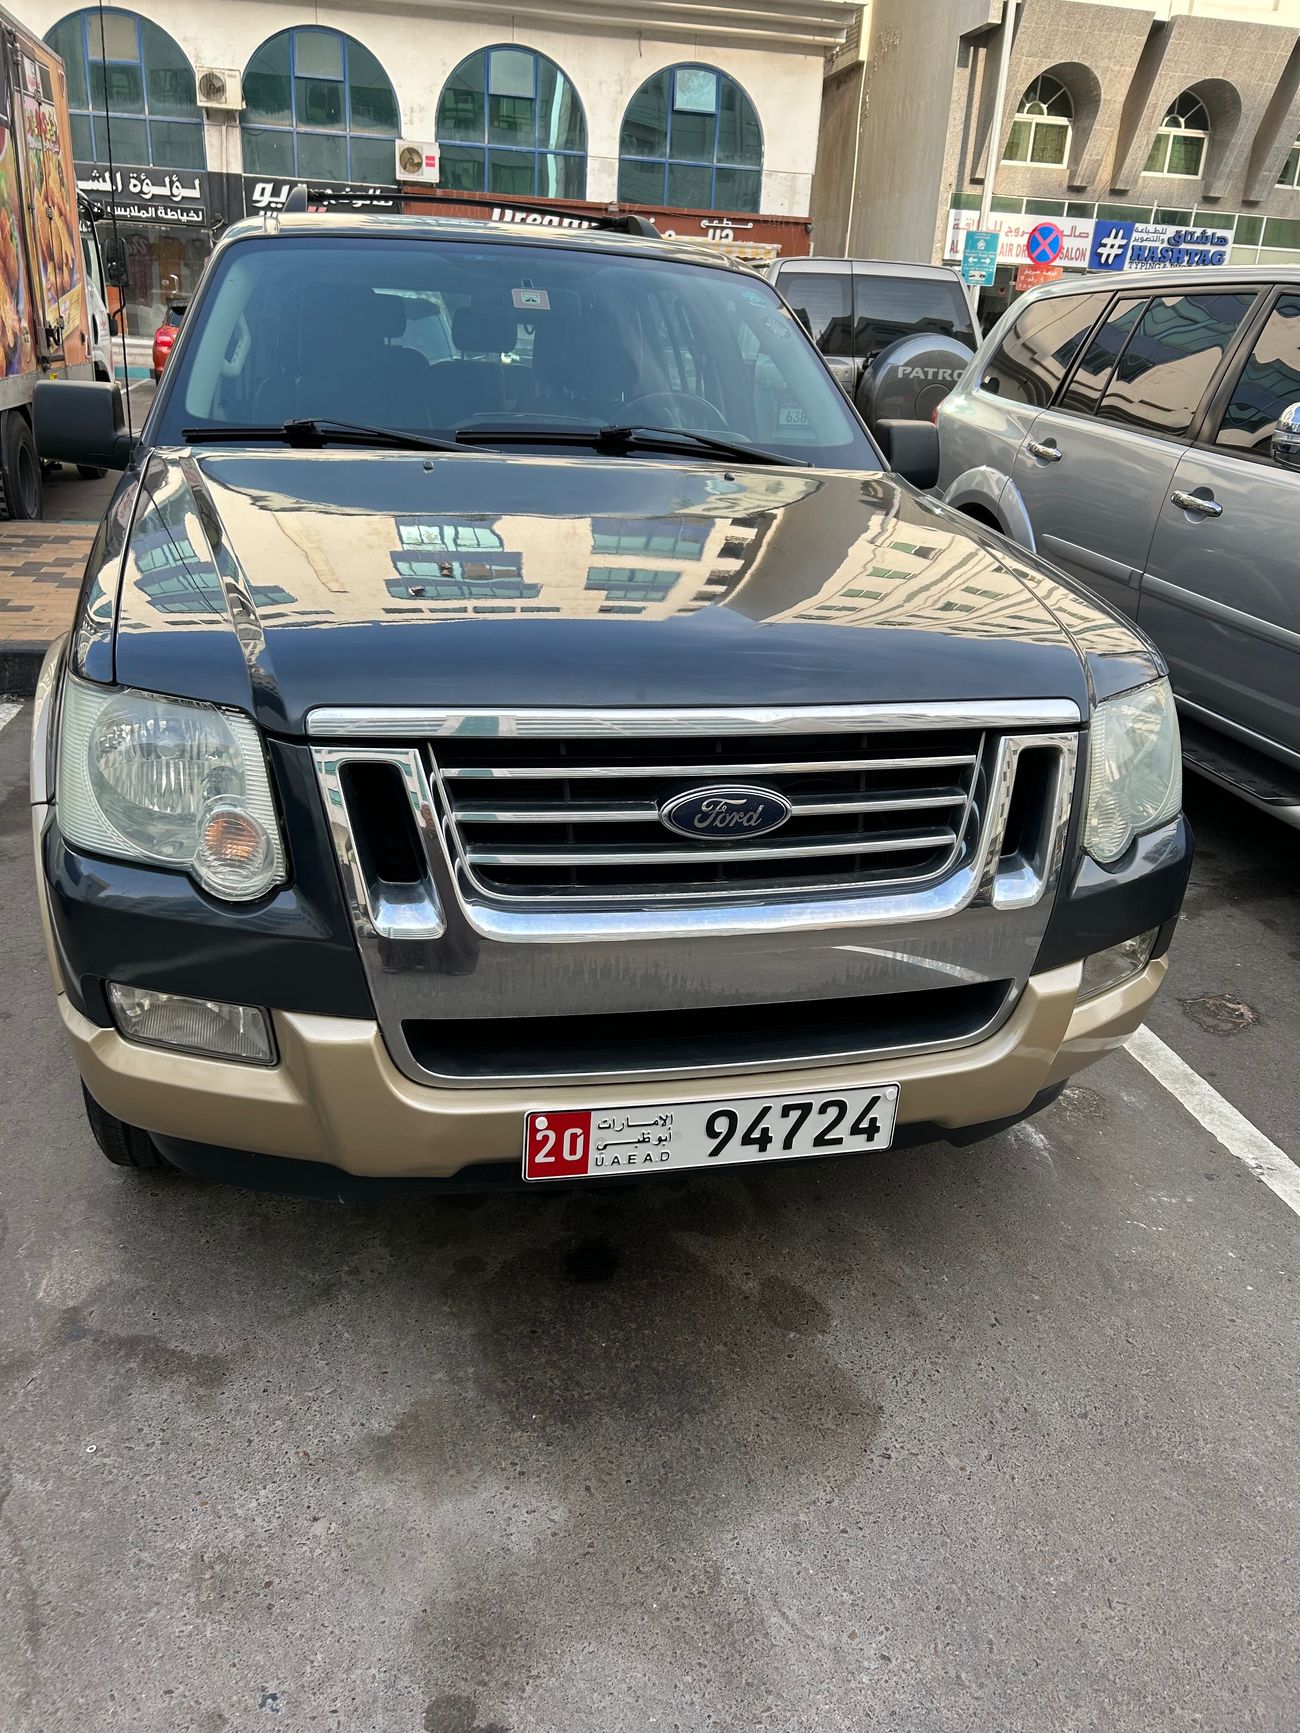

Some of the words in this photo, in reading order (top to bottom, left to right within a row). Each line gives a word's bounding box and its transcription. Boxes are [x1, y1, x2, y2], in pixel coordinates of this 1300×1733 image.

[1128, 261, 1161, 269] TYPING
[1129, 244, 1227, 265] HASHTAG
[693, 798, 765, 829] Ford
[704, 1095, 882, 1158] 94724
[533, 1127, 584, 1164] 20
